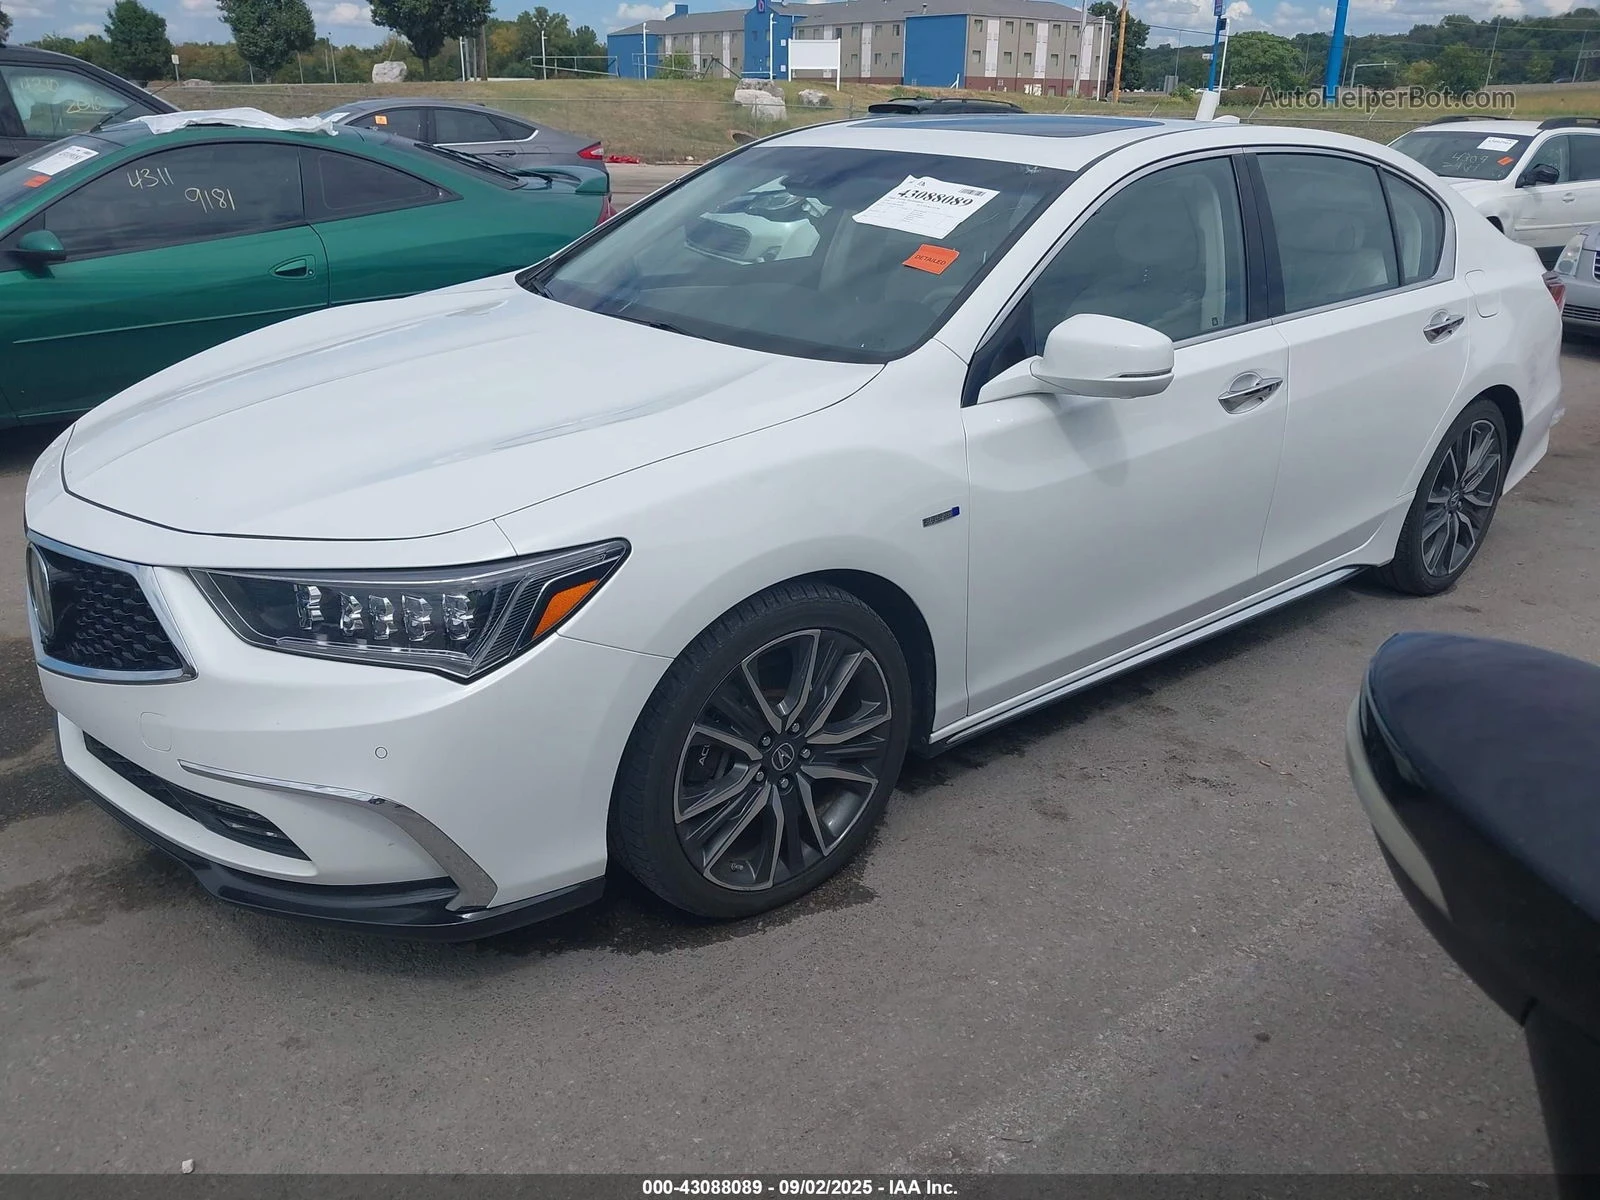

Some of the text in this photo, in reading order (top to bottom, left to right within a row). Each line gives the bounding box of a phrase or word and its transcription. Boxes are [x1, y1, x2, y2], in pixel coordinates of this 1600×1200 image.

[127, 167, 174, 190] 4311
[184, 187, 236, 214] 9181
[898, 188, 974, 208] 43088089
[914, 254, 947, 266] DETAILED
